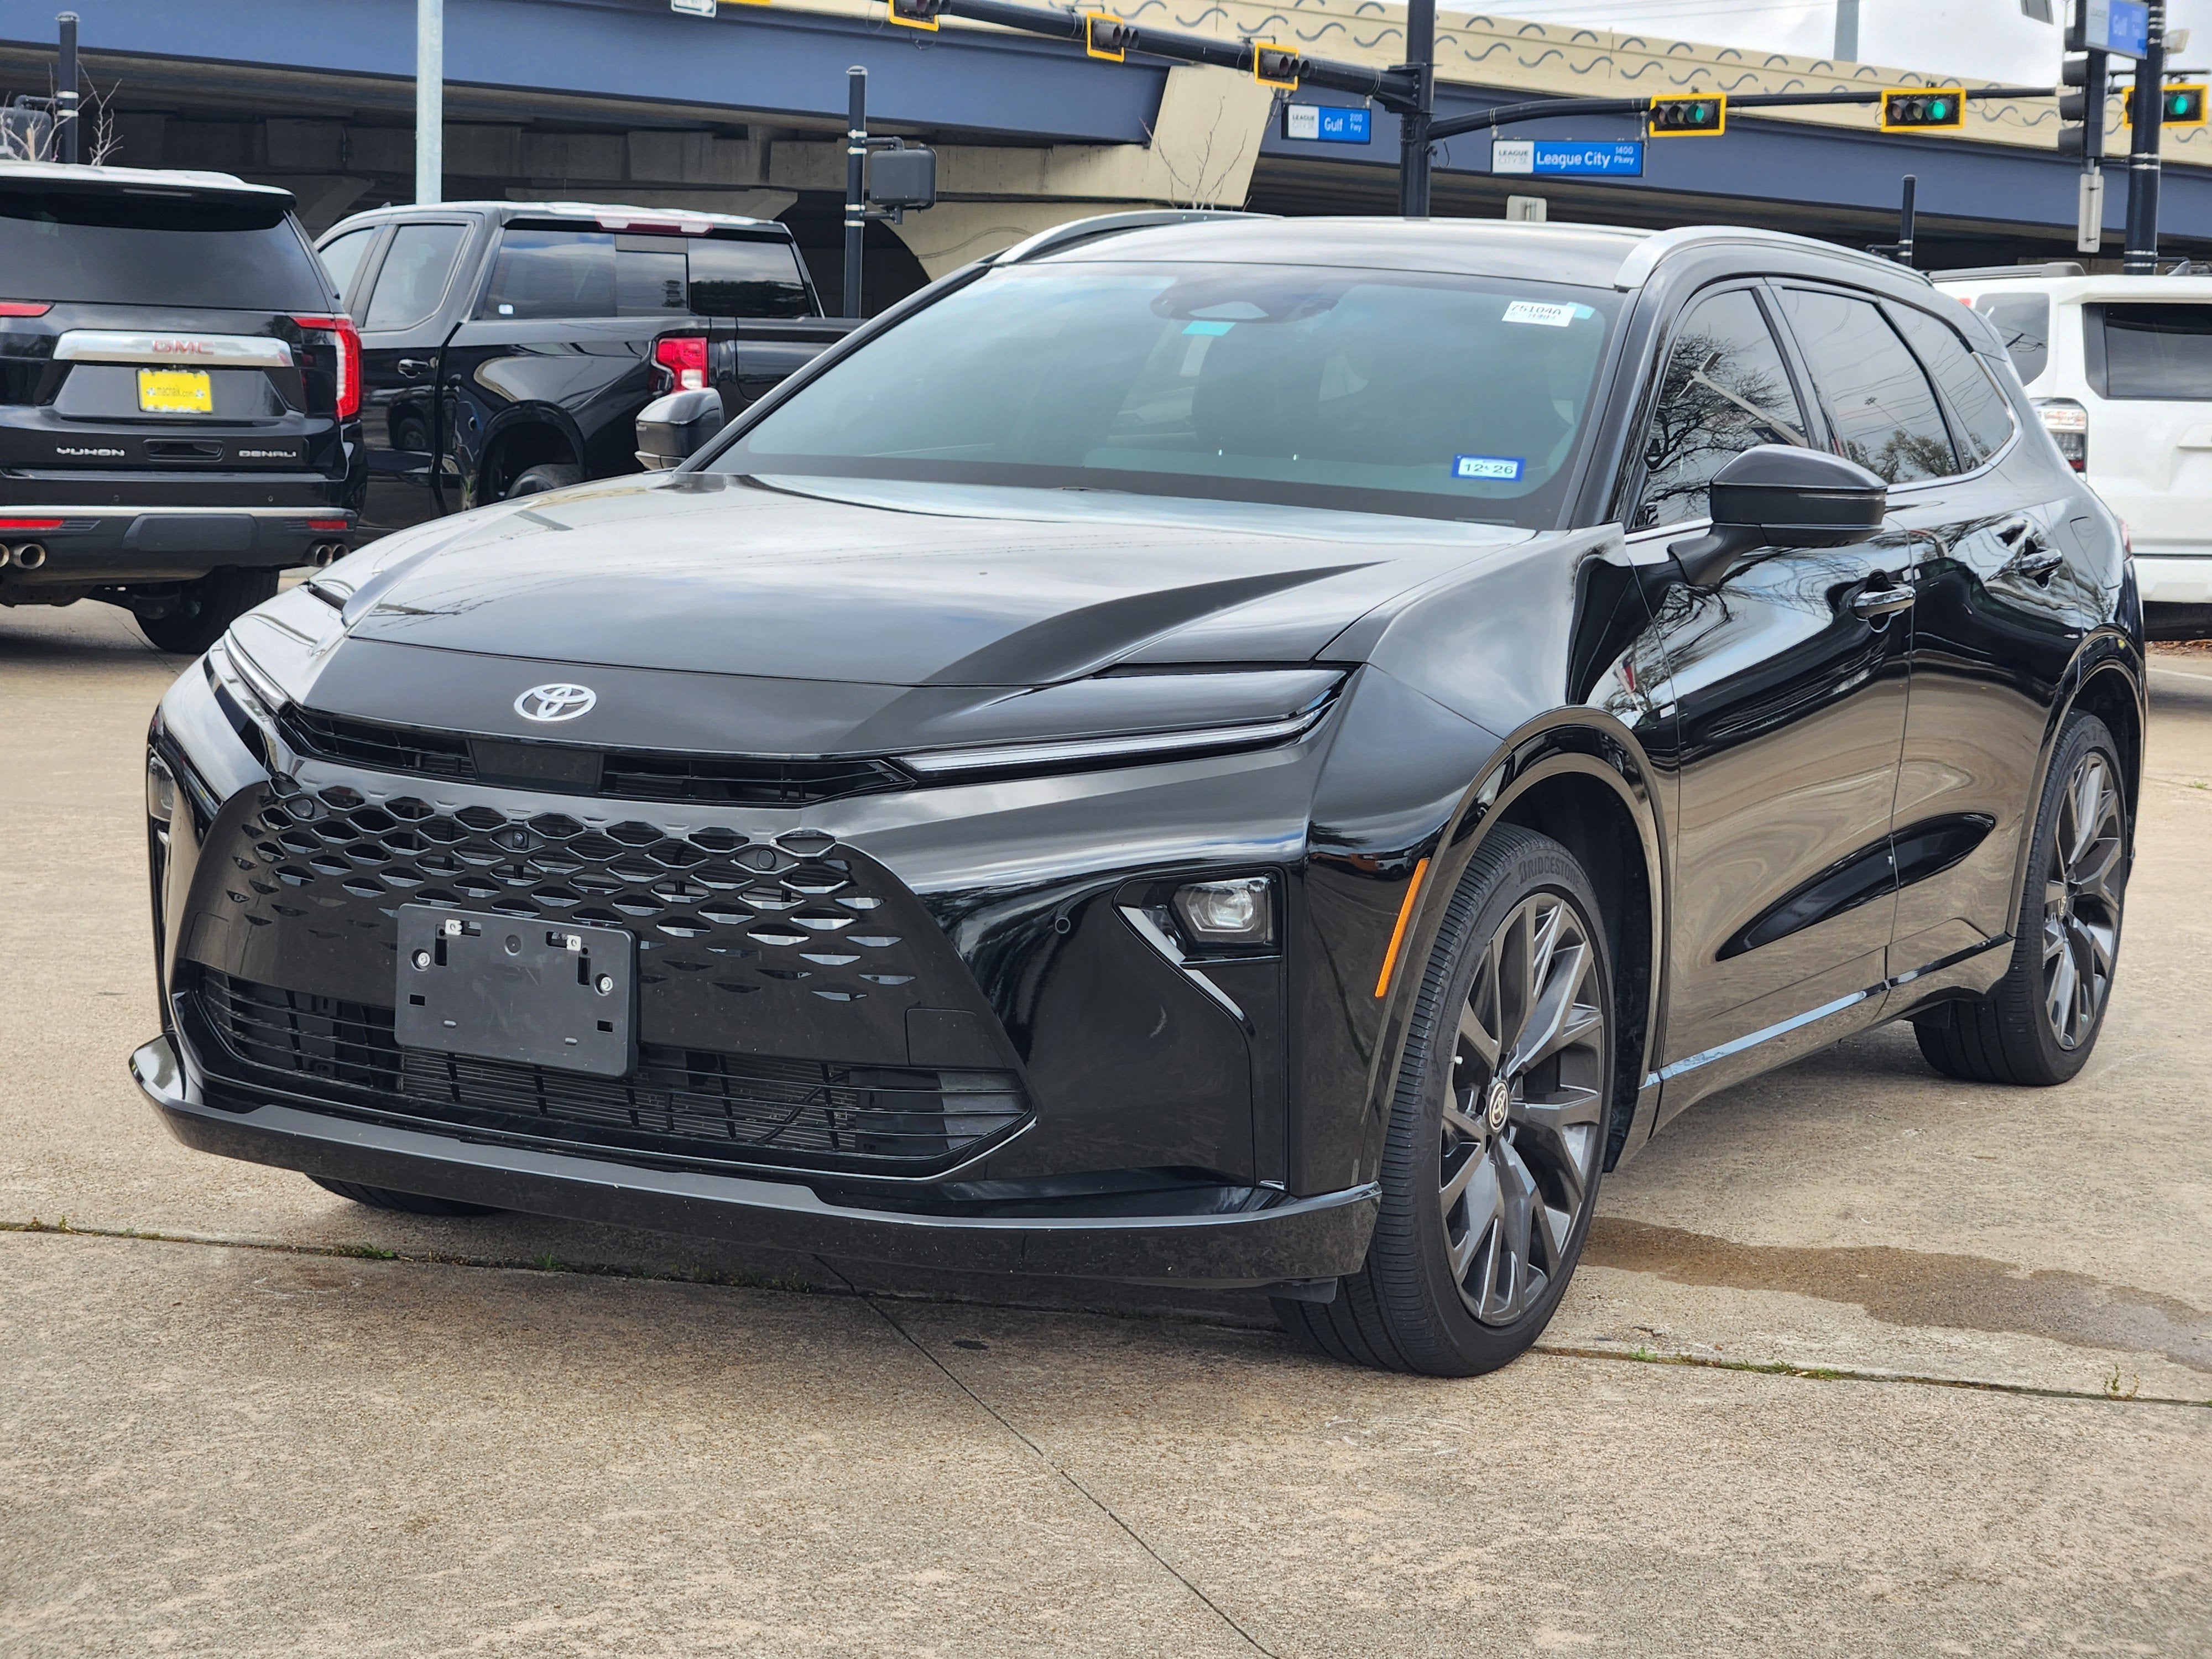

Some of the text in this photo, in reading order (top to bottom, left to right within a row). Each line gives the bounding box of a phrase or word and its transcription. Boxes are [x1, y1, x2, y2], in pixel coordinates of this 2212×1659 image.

[1324, 117, 1344, 132] Gulf
[1615, 146, 1634, 155] 1400
[1536, 150, 1611, 170] League City
[153, 340, 215, 355] GMC
[56, 447, 125, 457] YUKON
[238, 450, 296, 458] DENALI
[1465, 463, 1514, 474] 12 26
[1518, 856, 1580, 886] BRIDGESTONE
